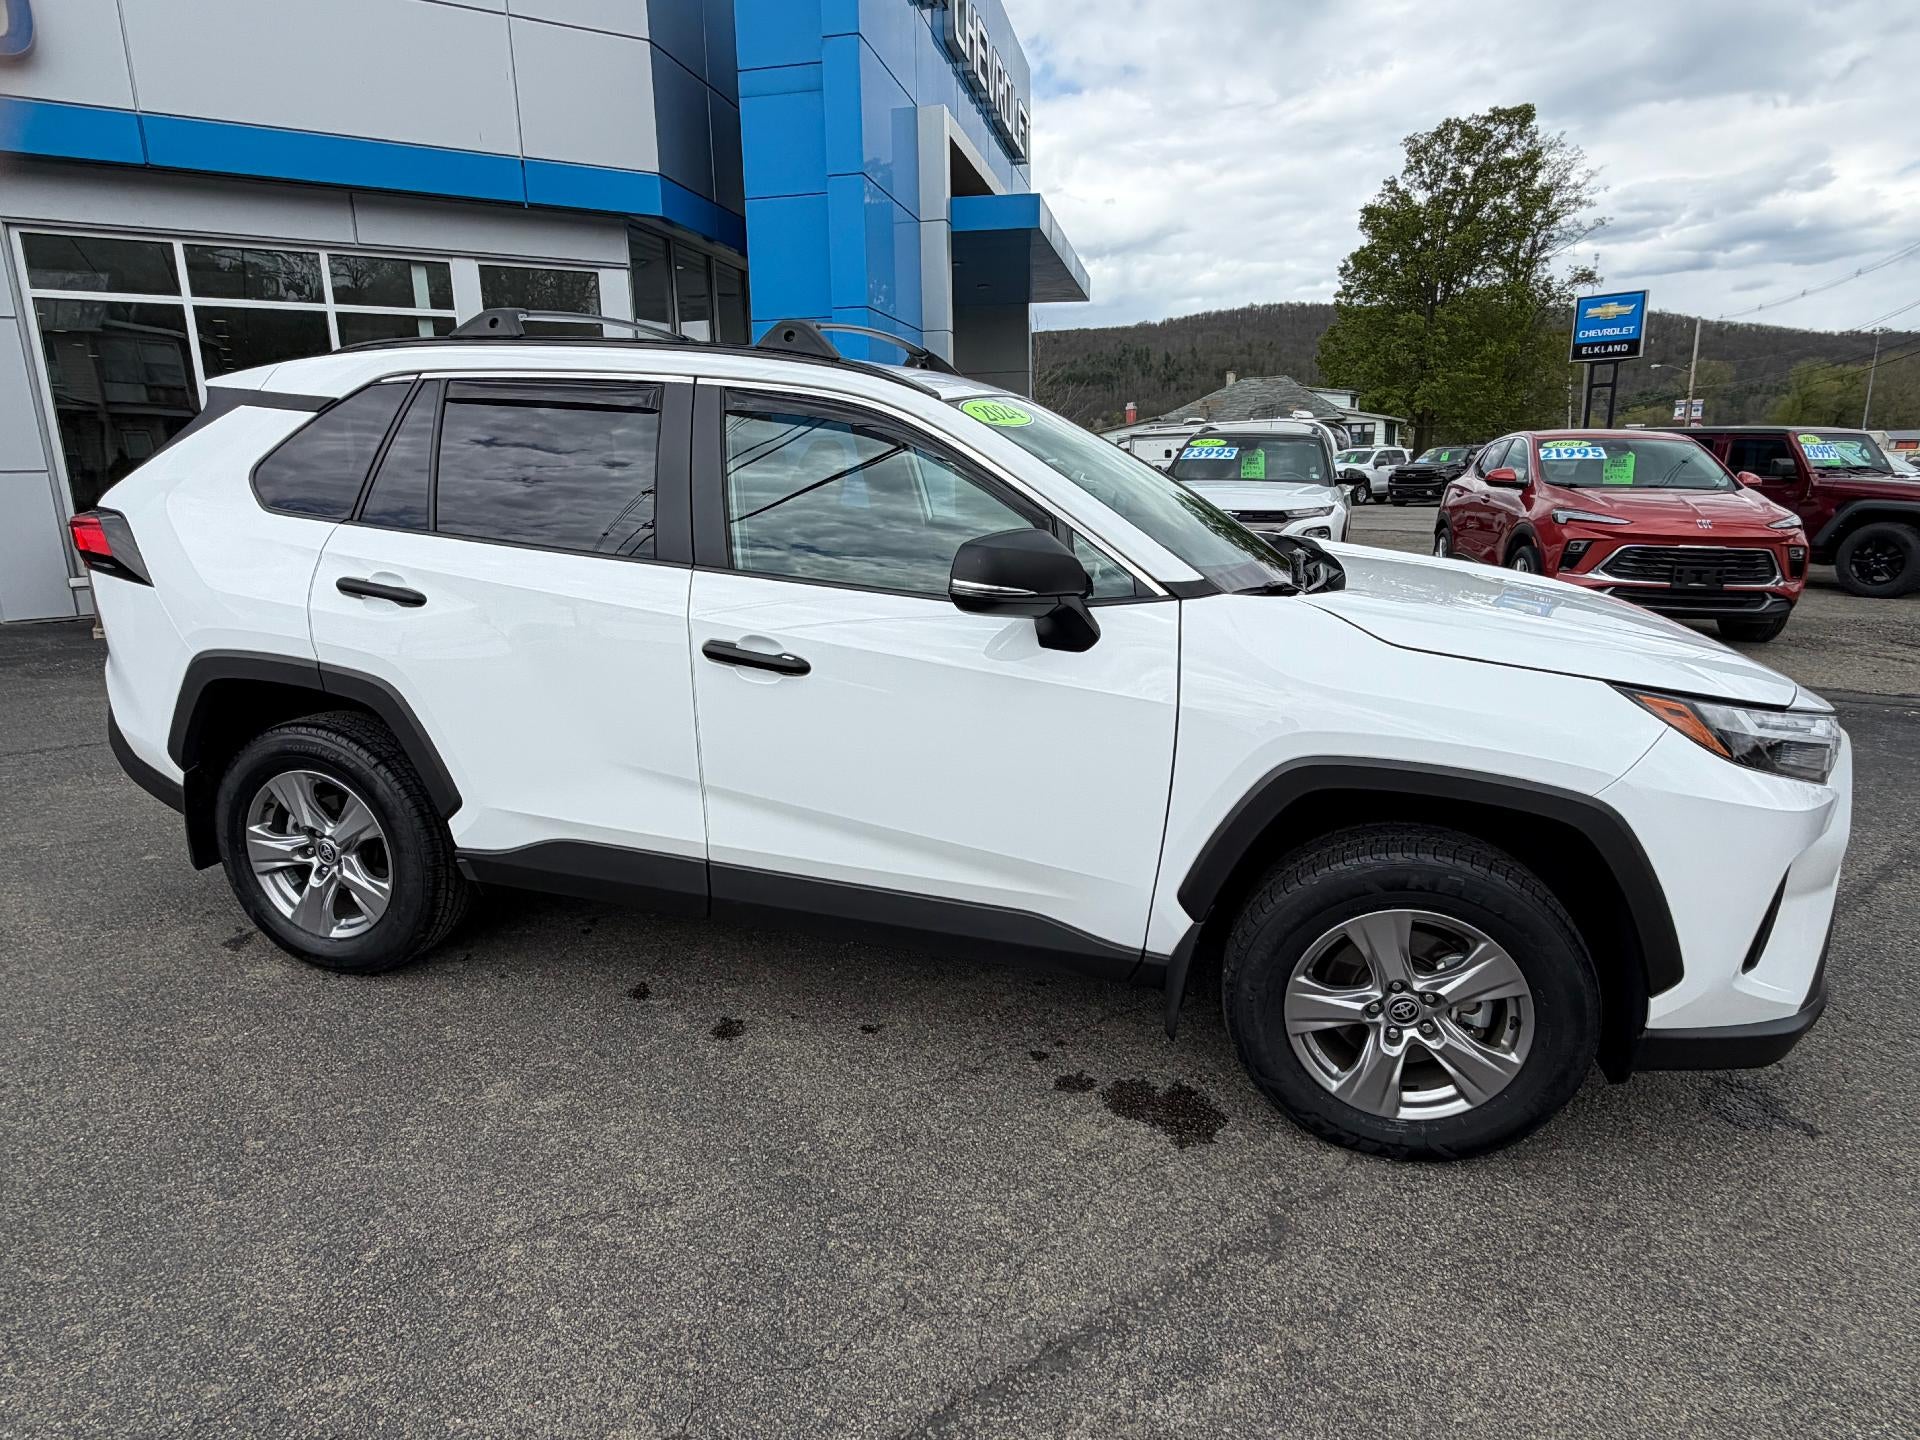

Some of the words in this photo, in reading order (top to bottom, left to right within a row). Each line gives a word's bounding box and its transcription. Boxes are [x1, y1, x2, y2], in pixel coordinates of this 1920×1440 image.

[1579, 326, 1635, 338] CHEVROLET
[1581, 344, 1629, 354] ELKLAND
[972, 404, 1026, 422] 2024
[1182, 447, 1236, 458] 23995
[1542, 447, 1603, 458] 21995
[1803, 445, 1837, 458] 28995
